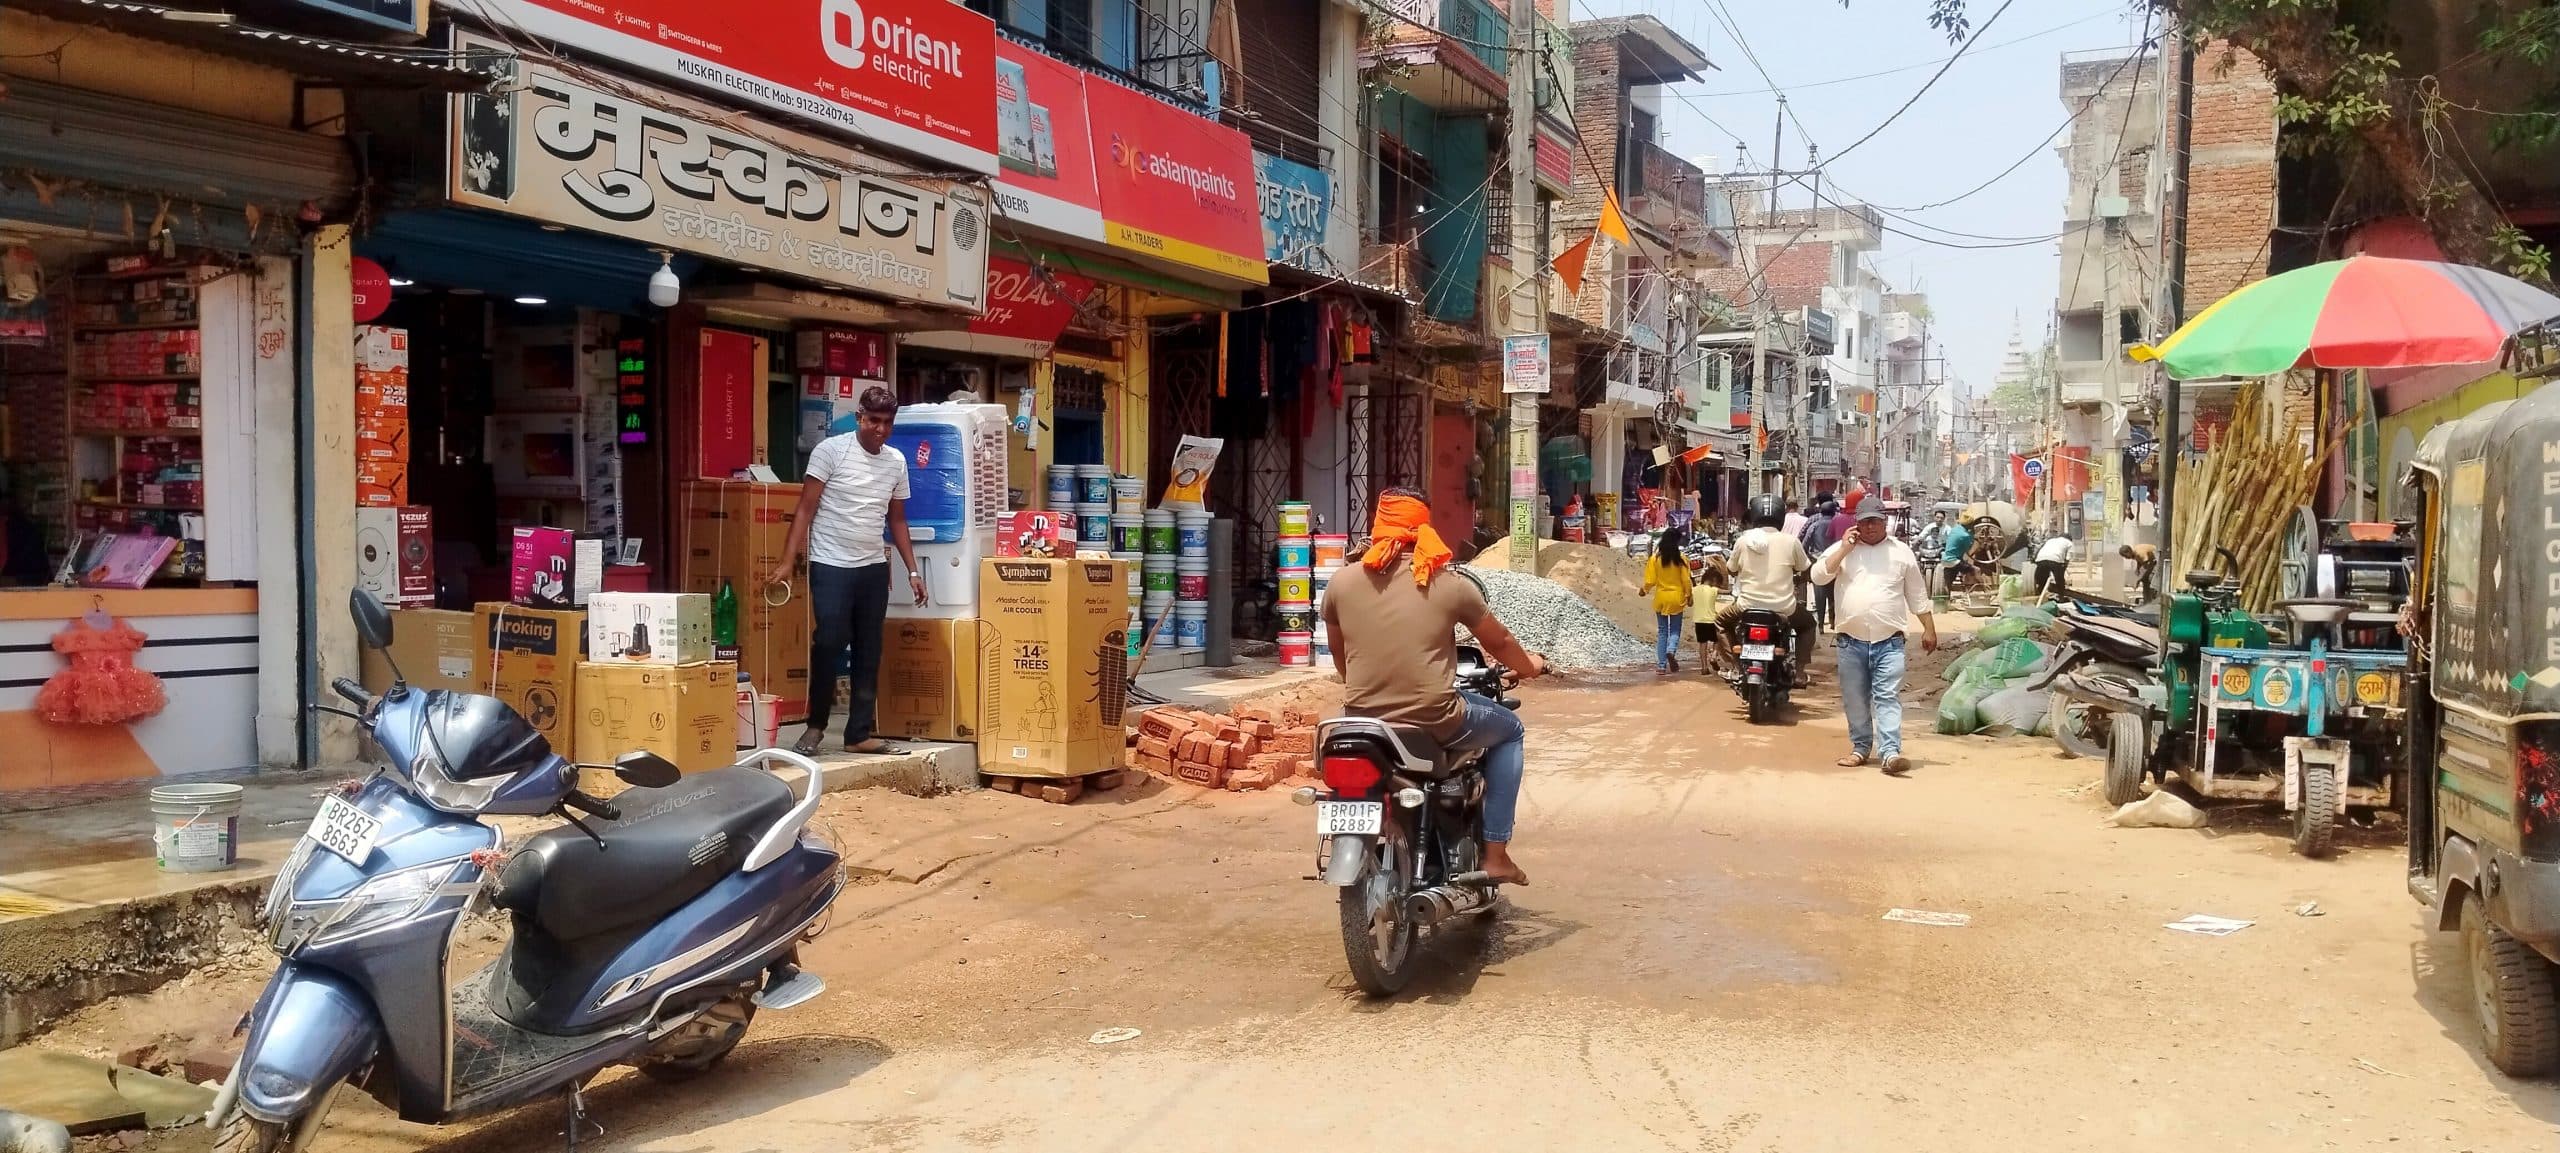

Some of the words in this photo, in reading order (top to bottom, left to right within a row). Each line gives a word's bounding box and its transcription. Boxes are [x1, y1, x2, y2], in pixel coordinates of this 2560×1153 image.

[625, 15, 651, 29] LIGHTING
[872, 16, 963, 78] orient
[873, 53, 933, 90] electric
[677, 58, 723, 83] MUSKAN
[725, 74, 770, 99] ELECTRIC
[772, 89, 795, 107] Mob:
[796, 98, 854, 125] 9123240743
[530, 72, 944, 255] मुस्कान
[1150, 152, 1236, 201] asianpaints
[994, 191, 1029, 214] RADERS
[1286, 180, 1322, 233] स्टोर
[779, 229, 803, 260] &
[1135, 232, 1164, 250] TRADERS
[726, 373, 734, 386] TV
[725, 389, 734, 423] SMART
[726, 426, 733, 440] LG
[400, 513, 428, 521] TEZUS
[1001, 565, 1049, 580] Symphony
[996, 597, 1019, 605] Master
[1020, 596, 1037, 605] Cool
[494, 620, 553, 641] Aroking
[1022, 645, 1041, 658] 14
[1013, 659, 1049, 670] TREES
[2225, 673, 2248, 694] शुभ
[2358, 681, 2385, 697] लाभ
[328, 803, 374, 840] BR26Z
[1331, 804, 1376, 818] BR01F
[1330, 818, 1375, 832] G2887
[322, 825, 358, 857] 8663
